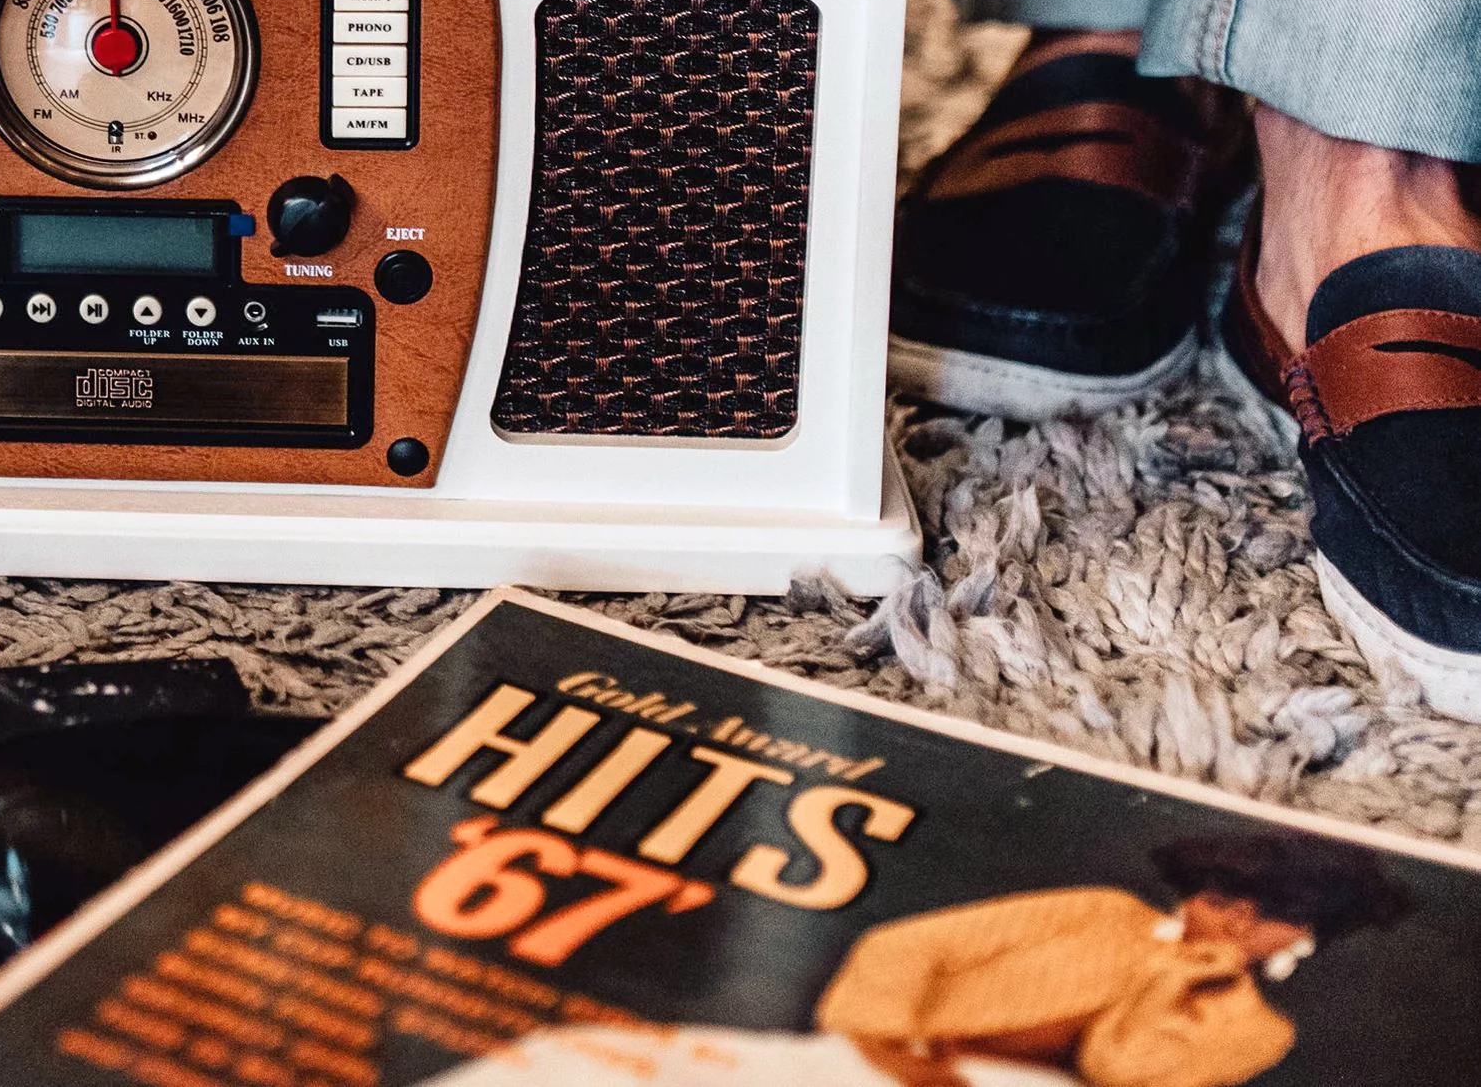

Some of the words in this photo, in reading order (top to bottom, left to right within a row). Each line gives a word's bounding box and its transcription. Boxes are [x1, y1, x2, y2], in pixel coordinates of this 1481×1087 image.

[210, 16, 231, 43] 108
[348, 23, 392, 32] PHONO
[40, 14, 59, 39] 530
[178, 27, 195, 56] 1710
[346, 57, 391, 66] CD/USB
[59, 89, 80, 99] AM
[147, 91, 173, 102] KHz
[353, 88, 384, 97] TAPE
[33, 109, 52, 120] FM
[178, 113, 206, 124] MHz
[347, 120, 388, 129] AM/FM
[134, 132, 147, 140] ST.
[386, 227, 425, 241] EJECT
[284, 264, 333, 277] TUNING
[129, 329, 170, 338] FOLDER
[182, 330, 224, 339] FOLDER
[143, 337, 157, 345] UP
[187, 338, 219, 346] DOWN
[238, 337, 261, 346] AUX
[263, 337, 275, 346] IN
[328, 338, 349, 347] USB
[98, 368, 151, 378] COMPACT
[76, 399, 116, 408] DIGITAL
[121, 399, 153, 409] AUDIO
[556, 669, 699, 726] Gold
[402, 681, 917, 911] HITS
